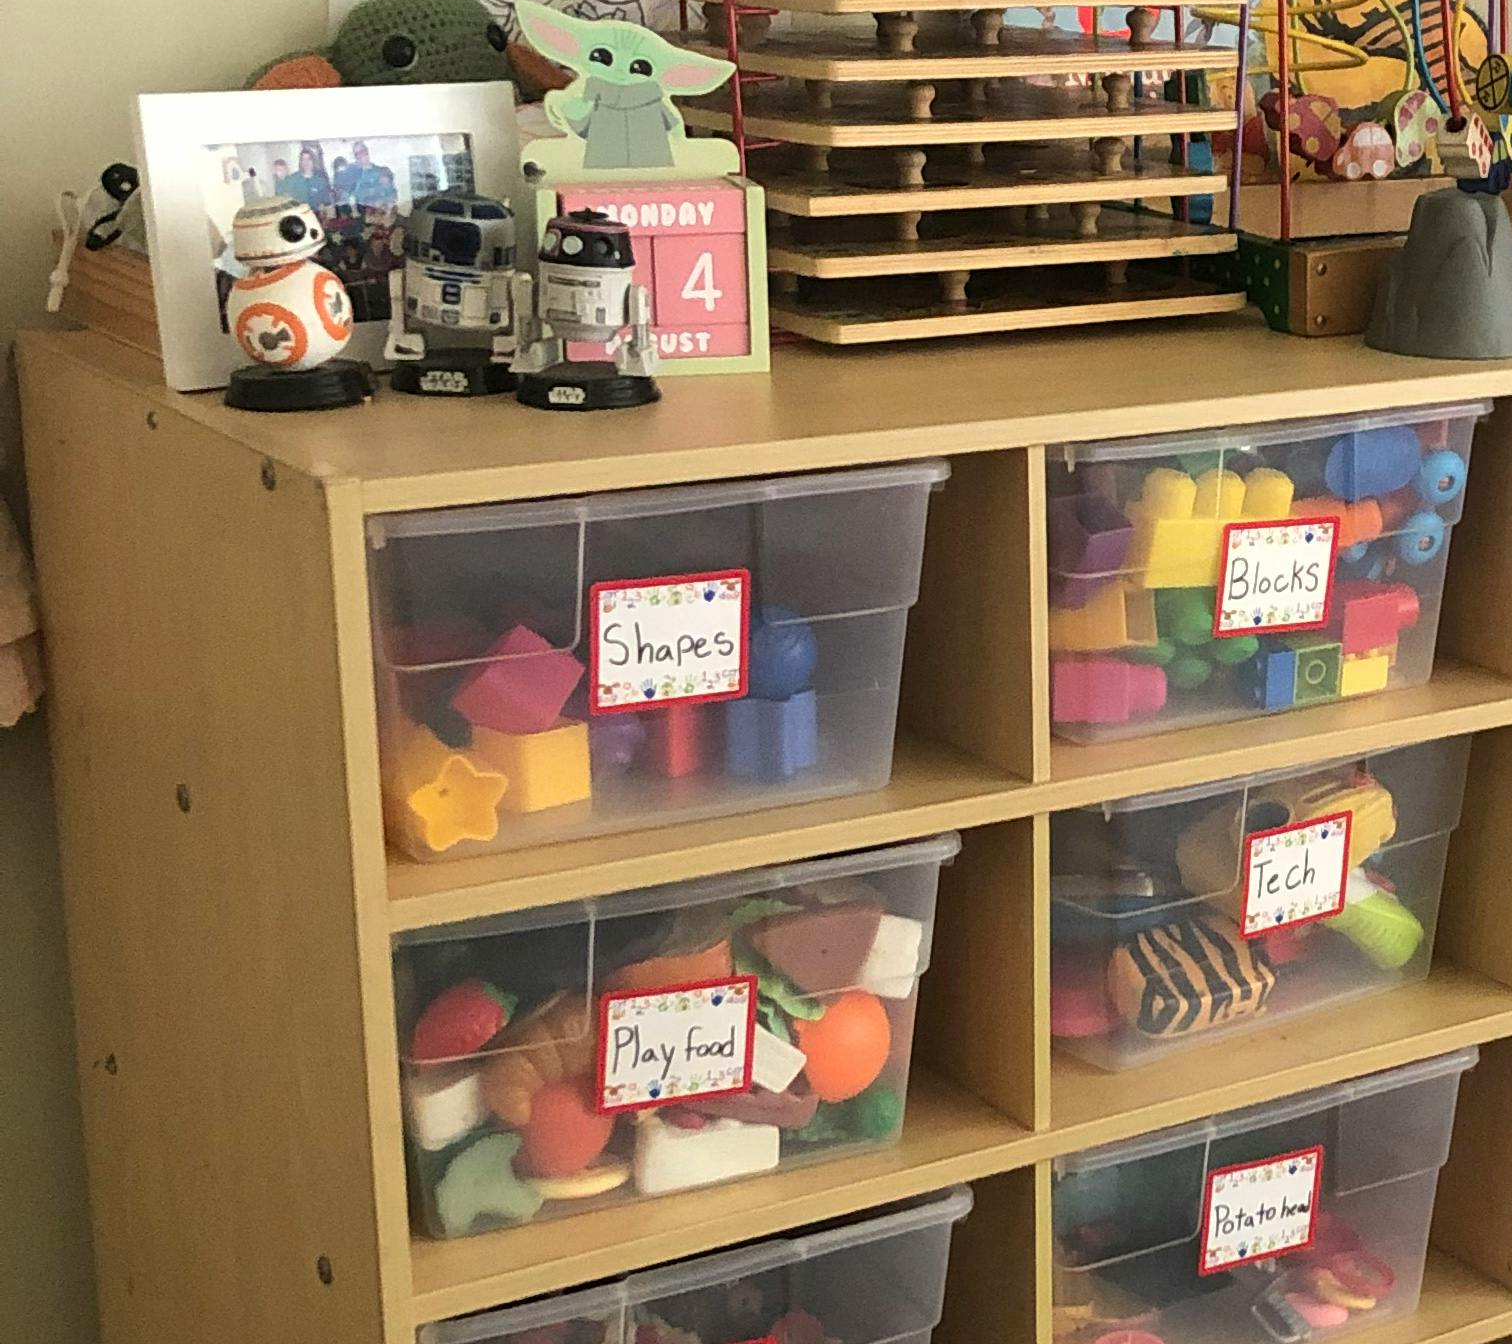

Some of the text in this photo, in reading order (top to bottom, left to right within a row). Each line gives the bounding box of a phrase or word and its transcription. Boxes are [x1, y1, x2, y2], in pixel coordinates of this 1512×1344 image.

[680, 251, 723, 312] 4
[1228, 556, 1320, 601] Blocks
[603, 621, 735, 667] Shapes
[1253, 847, 1316, 899] Tech
[611, 1023, 676, 1081] Play
